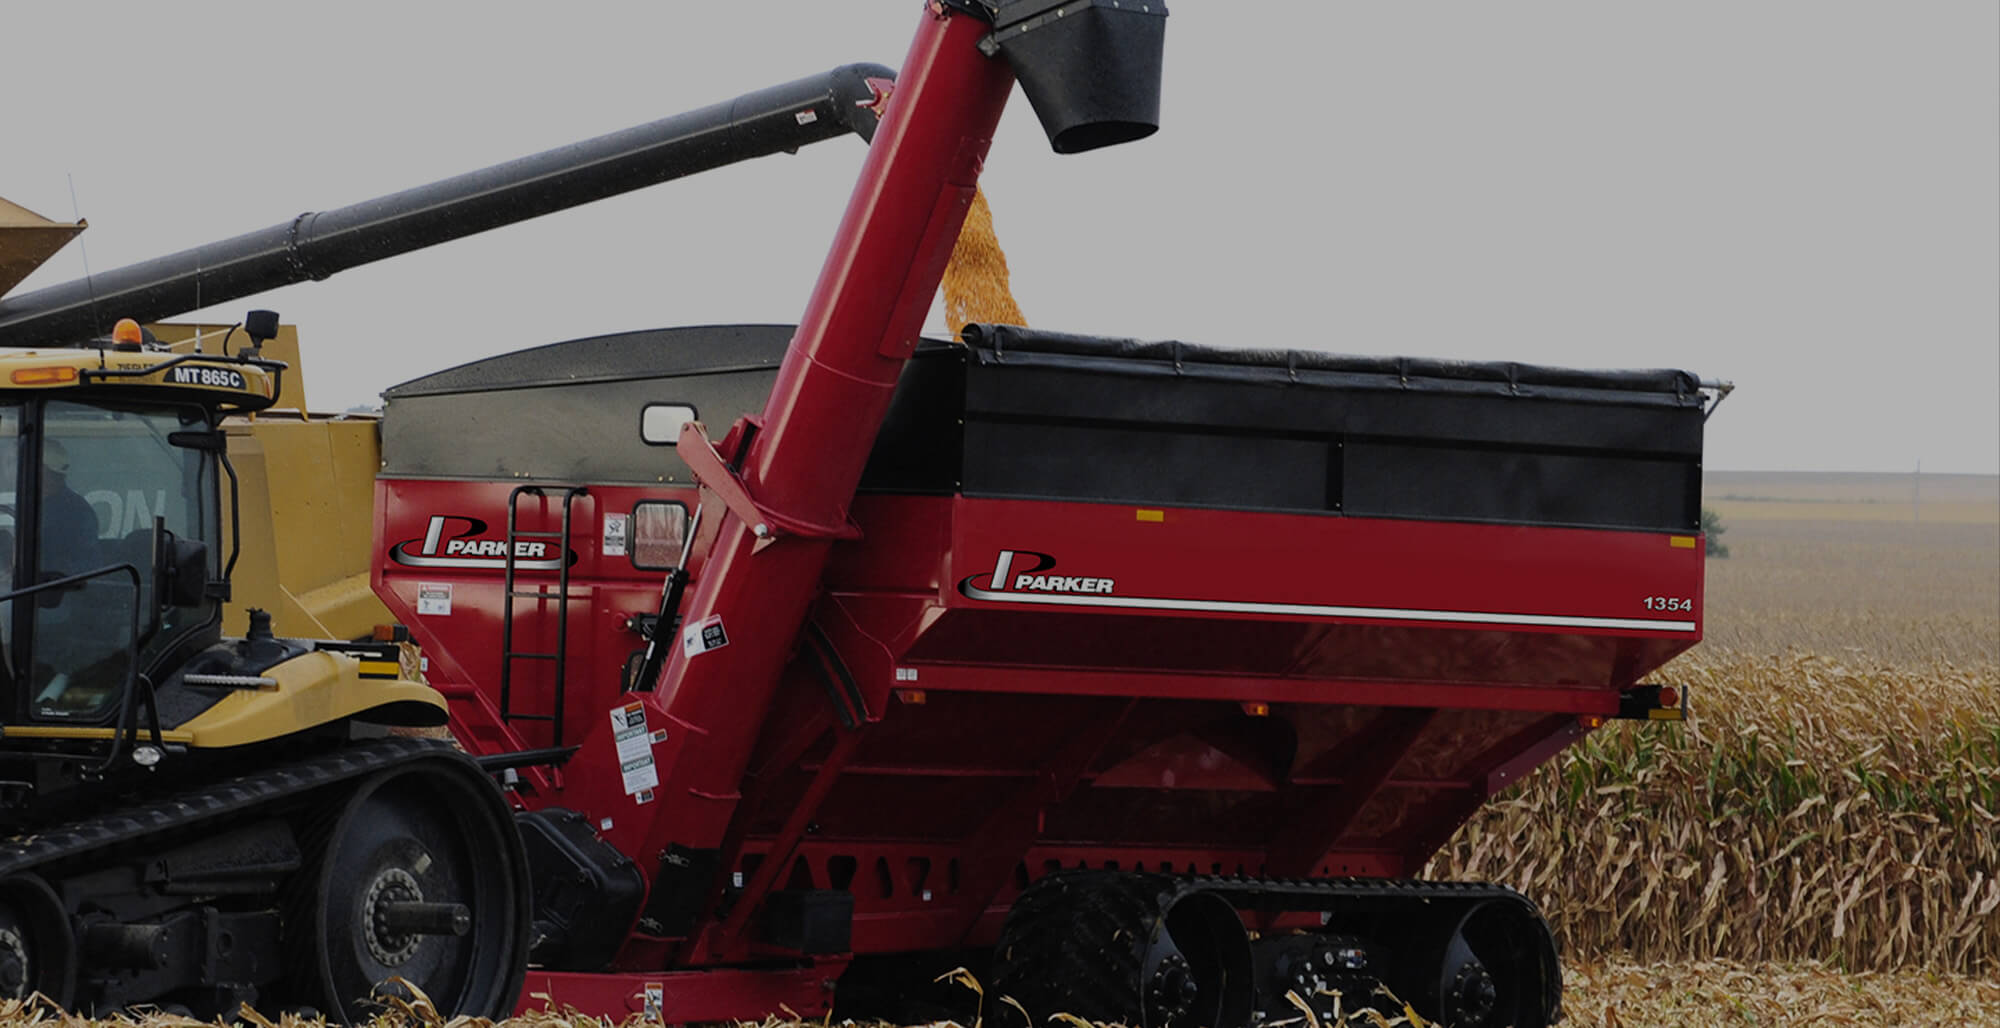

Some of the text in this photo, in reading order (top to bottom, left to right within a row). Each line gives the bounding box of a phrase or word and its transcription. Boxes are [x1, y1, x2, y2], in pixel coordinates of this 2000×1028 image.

[446, 540, 546, 557] PARKER
[1014, 574, 1115, 594] PARKER
[1643, 596, 1693, 612] 1354
